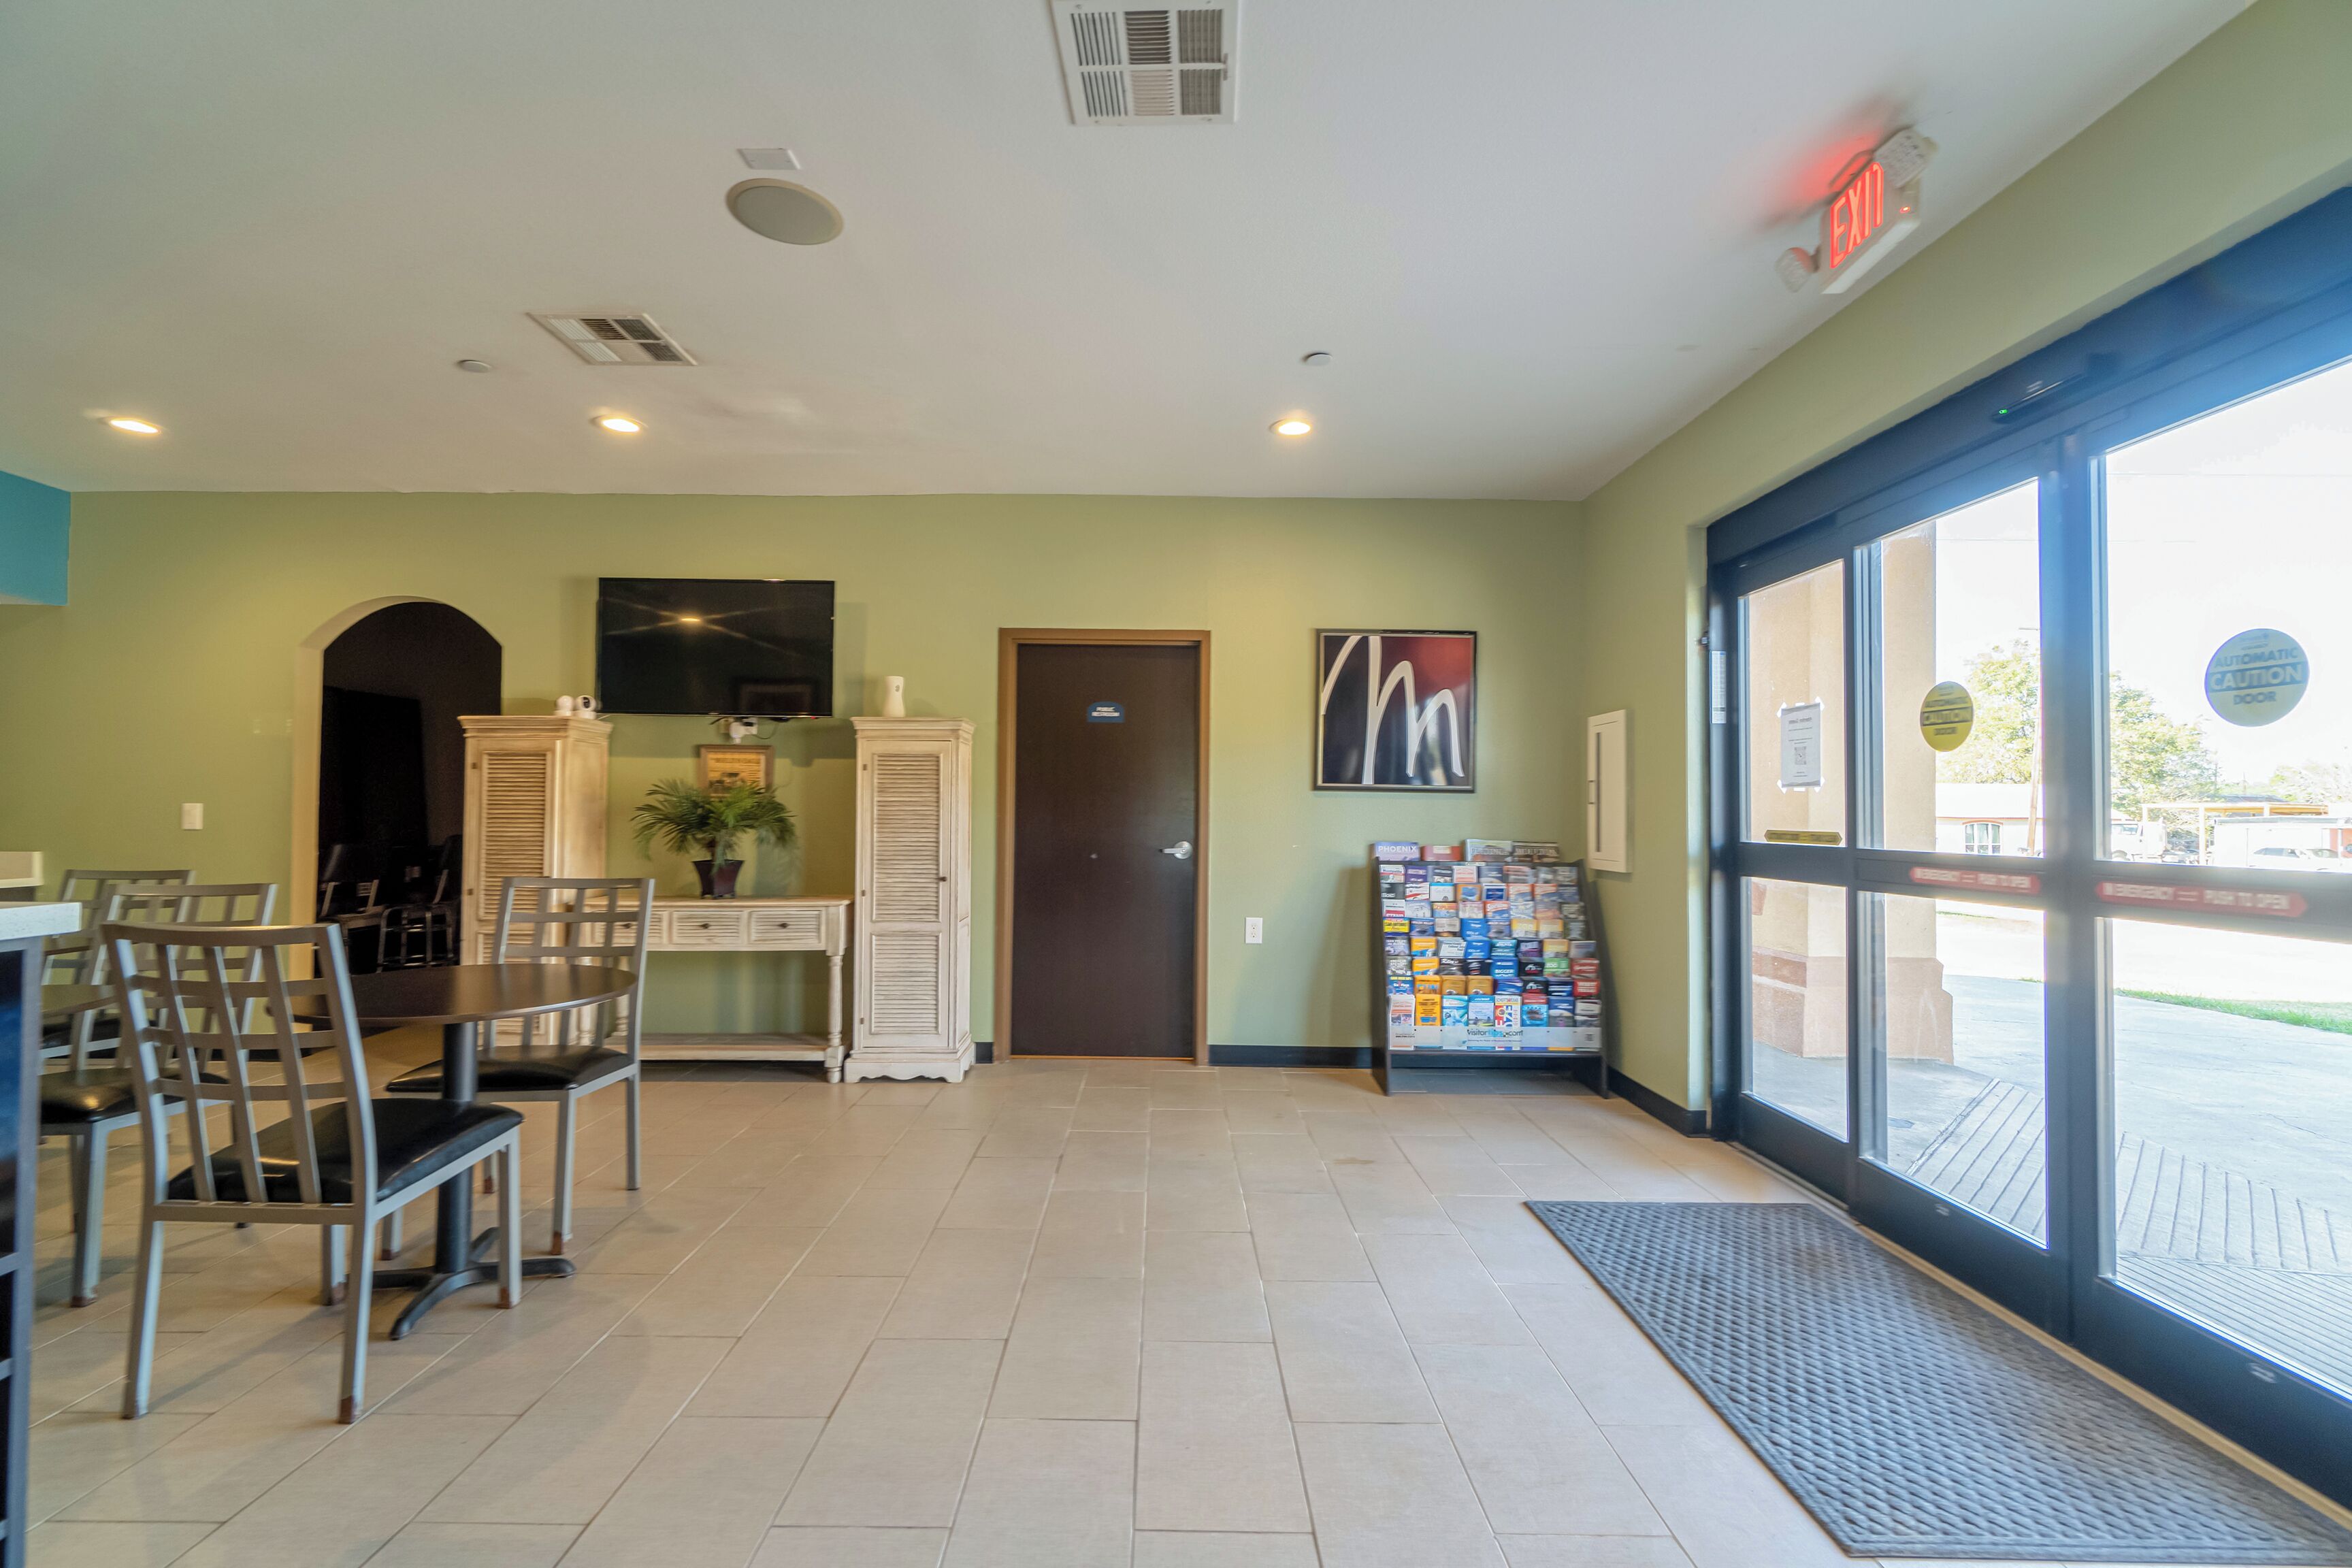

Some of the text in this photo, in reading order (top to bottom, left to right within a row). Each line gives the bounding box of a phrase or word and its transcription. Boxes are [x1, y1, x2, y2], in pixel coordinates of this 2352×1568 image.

[1831, 162, 1884, 268] EXIT
[2214, 647, 2299, 668] AUTOMATIC
[2210, 664, 2303, 690] CAUTION
[2233, 691, 2276, 705] DOOR
